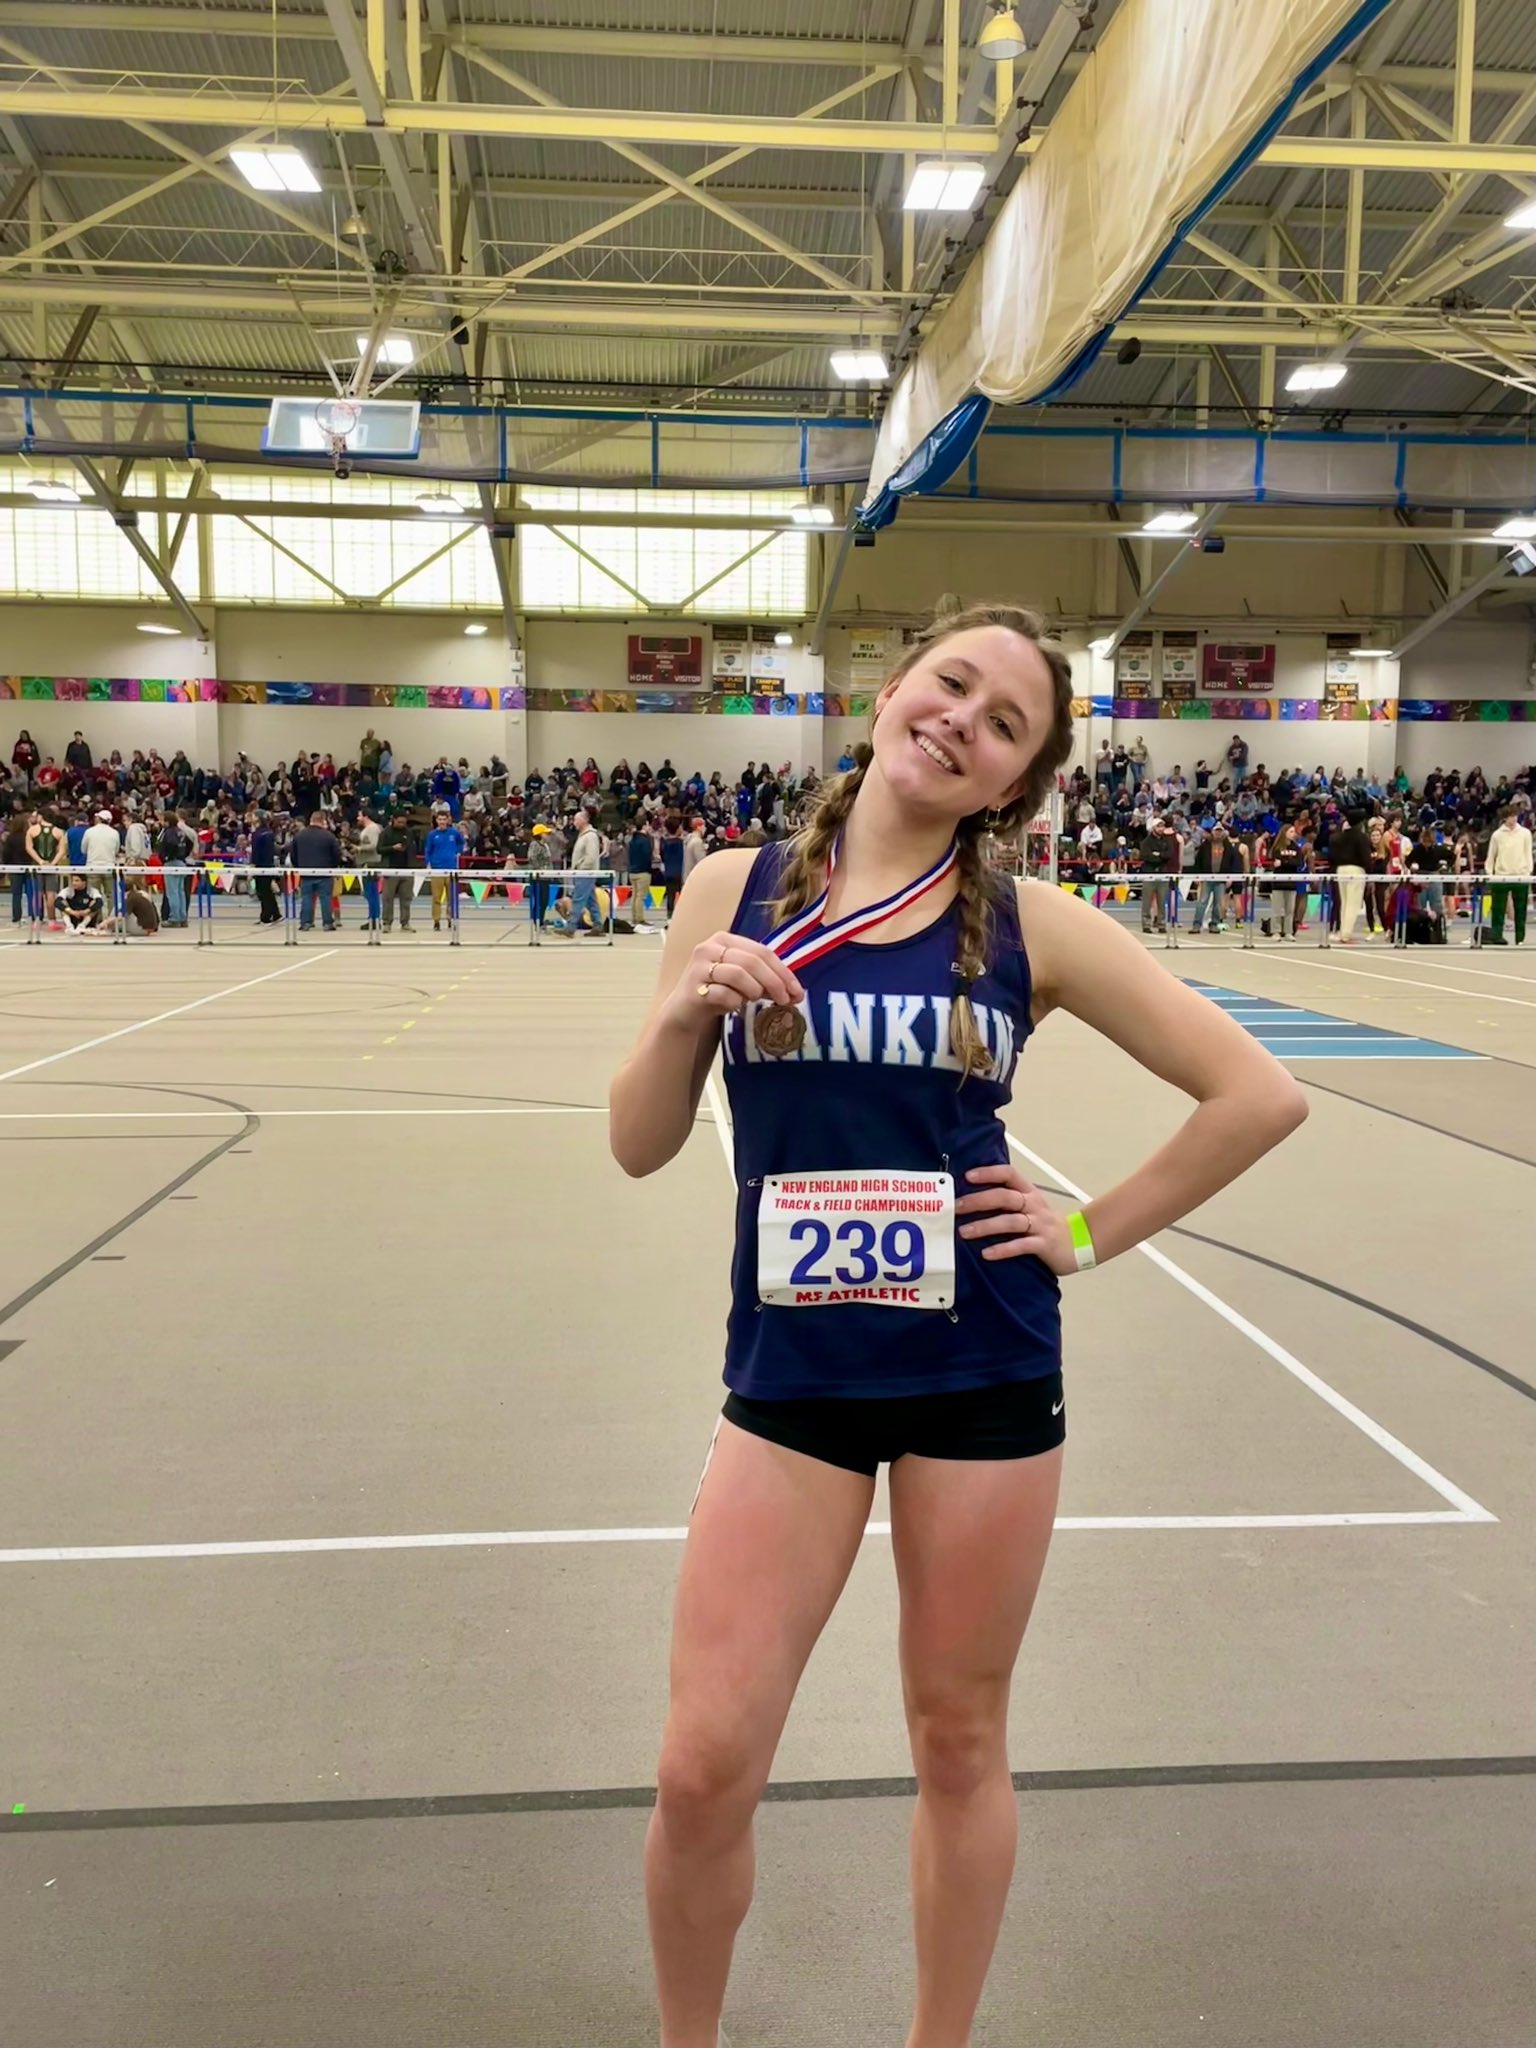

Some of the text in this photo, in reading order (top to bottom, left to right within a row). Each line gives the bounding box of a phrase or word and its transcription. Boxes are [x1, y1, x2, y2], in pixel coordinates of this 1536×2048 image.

[629, 674, 701, 683] HOME VISITOR
[1204, 681, 1229, 689] HOME
[781, 1179, 938, 1194] NEW ENGLAND HIGH SCHOOL
[775, 1198, 944, 1212] TRACK & FIELD CHAMPIONSHIP
[789, 1218, 925, 1285] 239
[828, 1287, 920, 1302] ATHLETIC
